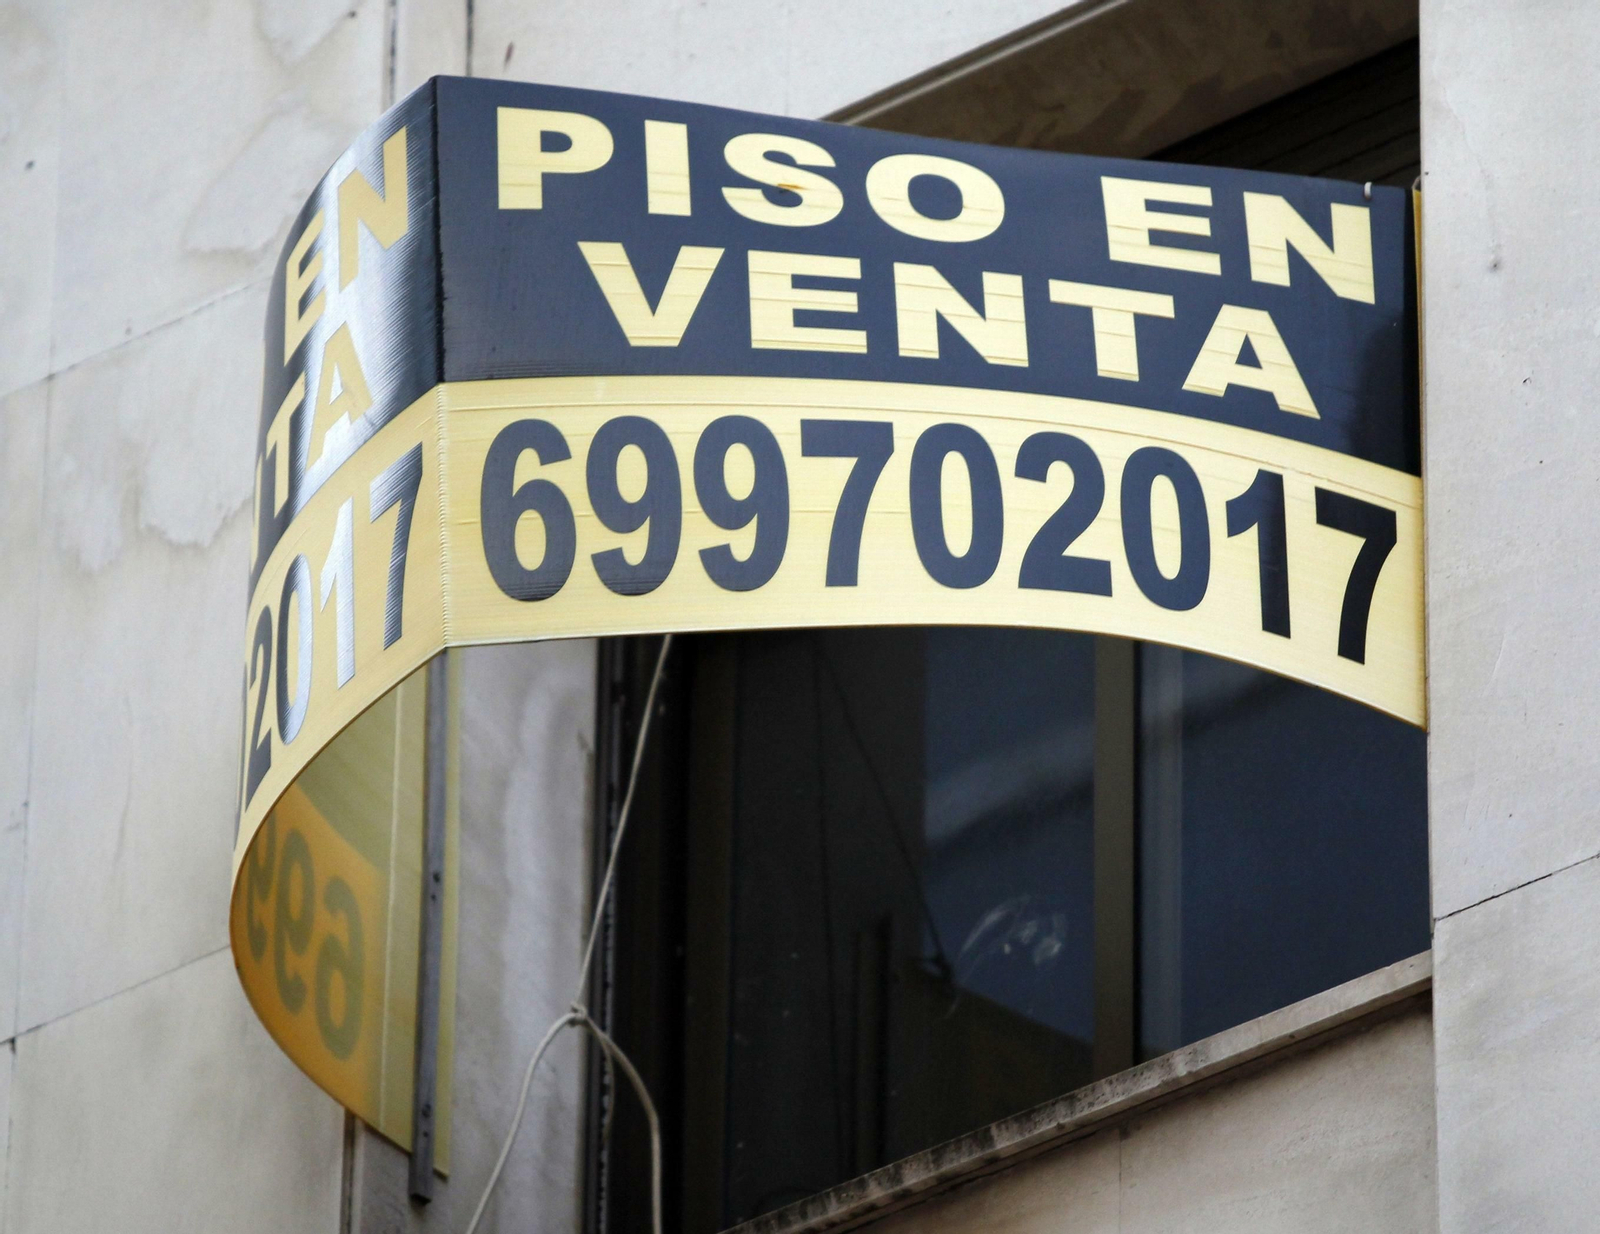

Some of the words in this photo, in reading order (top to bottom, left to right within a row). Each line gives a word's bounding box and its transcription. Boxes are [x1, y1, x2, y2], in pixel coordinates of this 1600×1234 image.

[284, 125, 409, 368] EN
[497, 106, 1005, 243] PISO
[1101, 176, 1376, 304] EN
[577, 241, 1321, 419] VENTA
[233, 441, 423, 850] 2017
[480, 414, 1398, 666] 699702017
